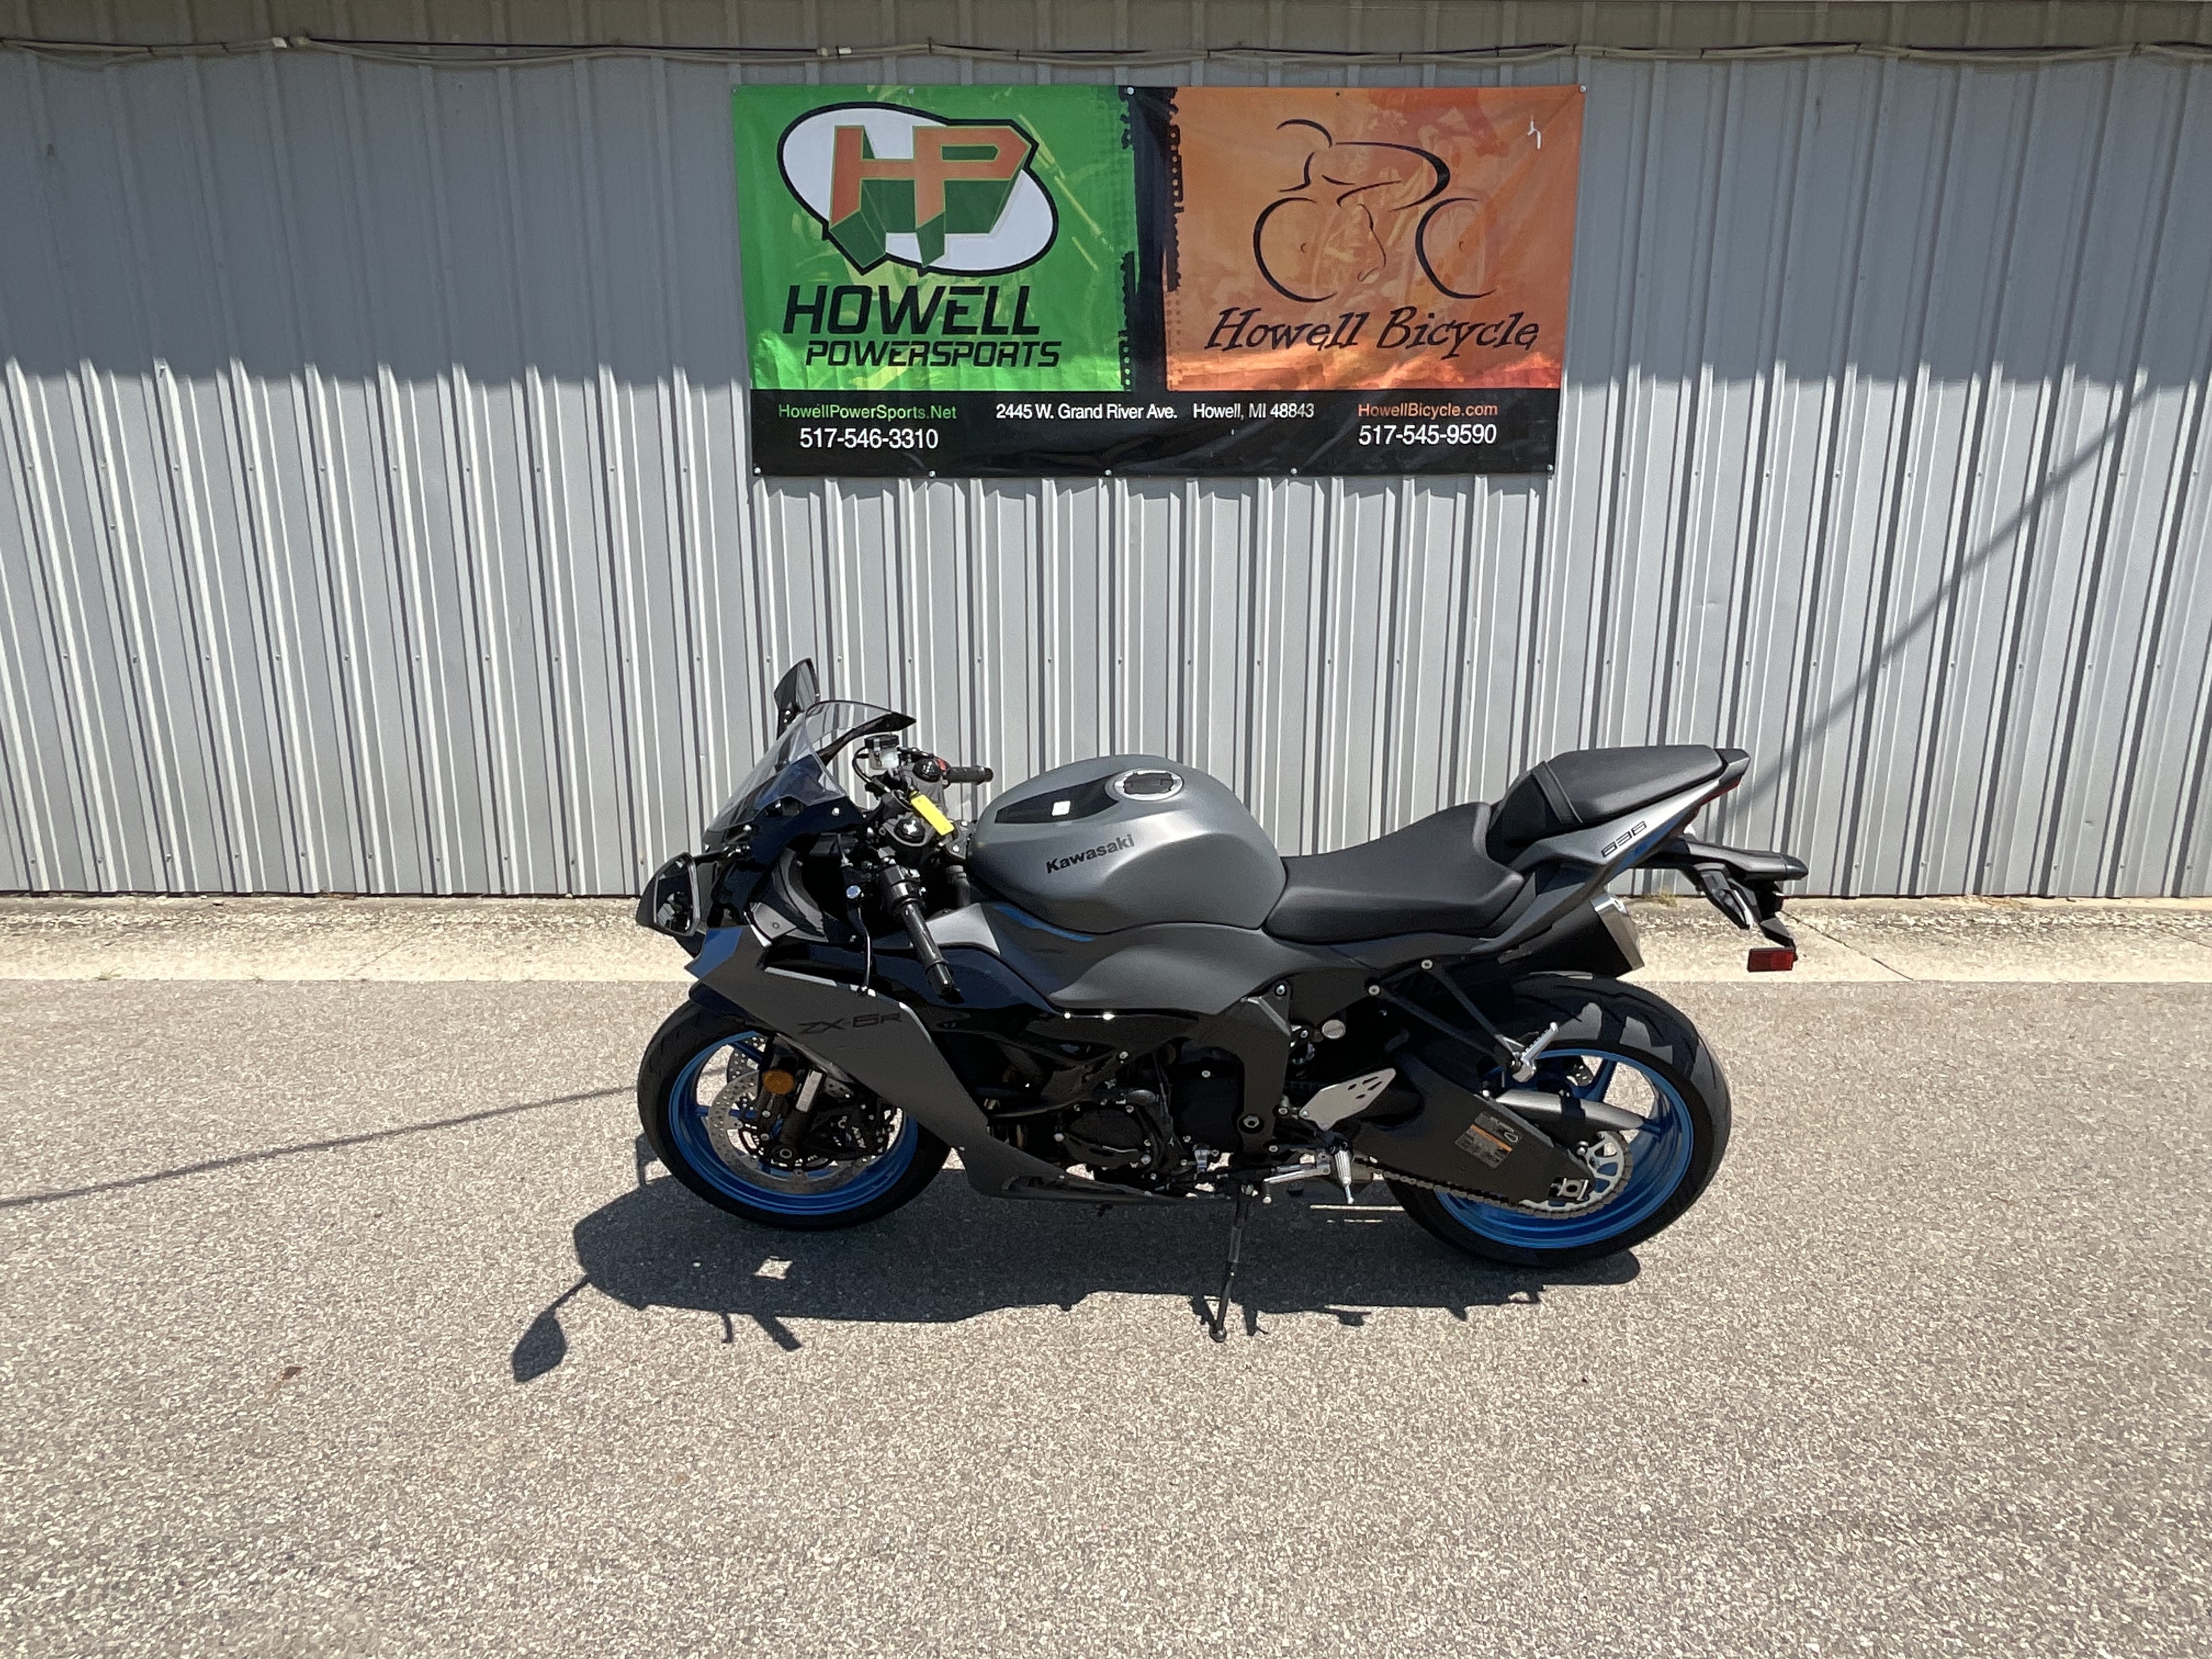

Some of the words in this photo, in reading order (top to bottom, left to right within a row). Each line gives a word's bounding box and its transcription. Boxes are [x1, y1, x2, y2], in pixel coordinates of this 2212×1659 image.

[828, 125, 1032, 267] HP
[782, 285, 1040, 335] HOWELL
[1204, 307, 1370, 352] Howell
[1376, 306, 1539, 359] Bicycle
[805, 341, 1062, 367] POWERSPORTS
[778, 404, 957, 422] HowellPowerSports.Net
[996, 404, 1032, 419] 2445
[1035, 404, 1054, 419] W.
[1058, 404, 1103, 419] Grand
[1107, 404, 1144, 419] River
[1146, 404, 1177, 419] Ave.
[1193, 403, 1244, 420] Howell,
[1249, 403, 1266, 418] MI
[1269, 403, 1314, 418] 48843
[1358, 403, 1499, 420] HowellBicycle.com
[799, 428, 939, 448] 517-546-3310
[1358, 424, 1497, 445] 517-545-9590
[1046, 834, 1135, 874] Kawasaki
